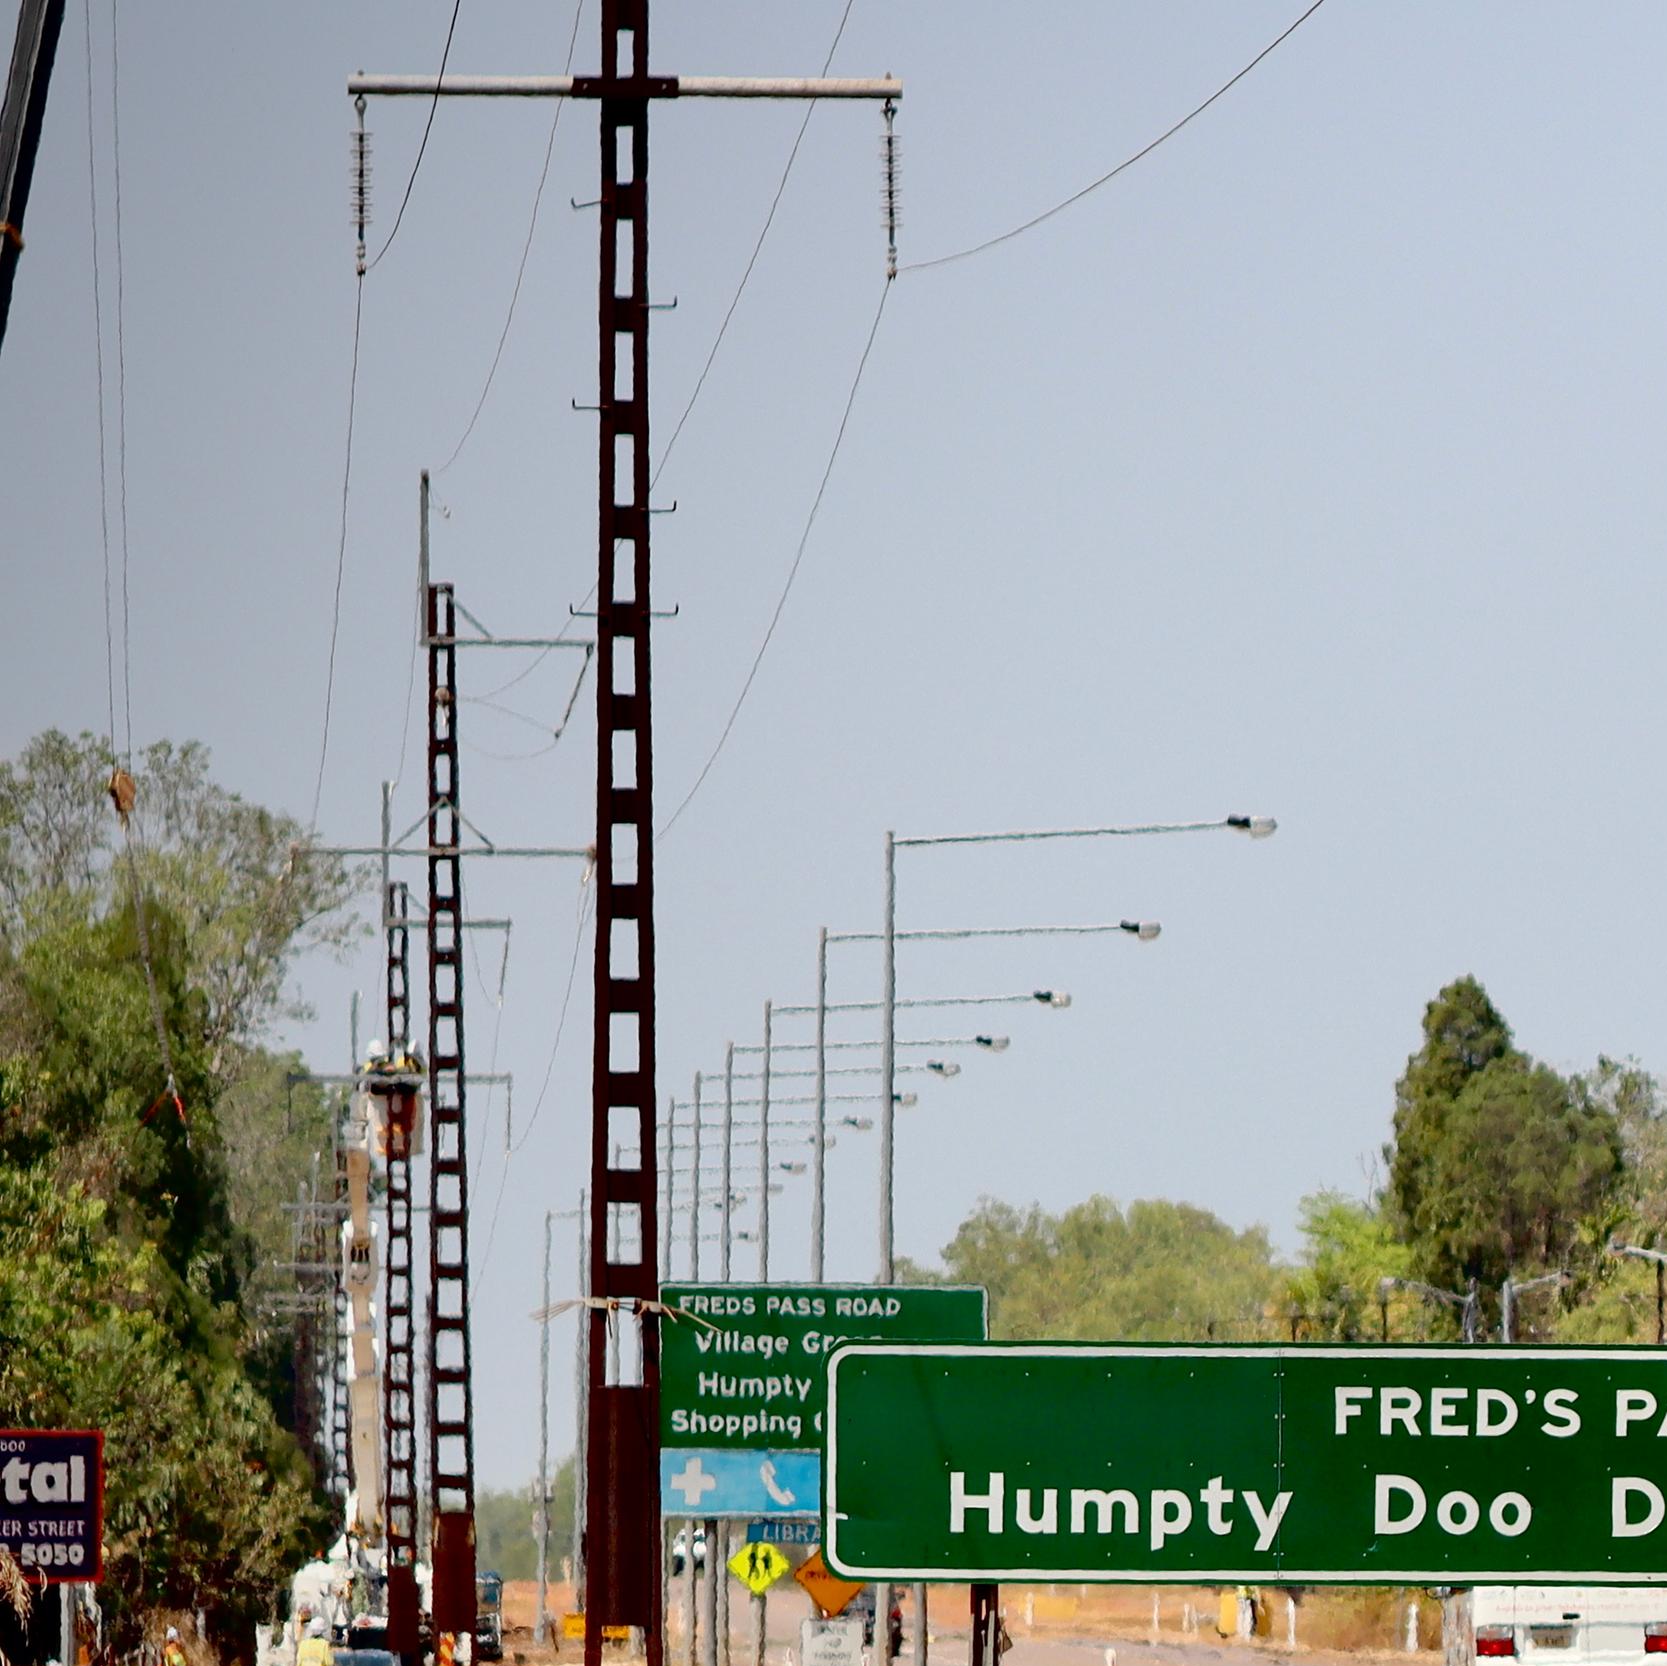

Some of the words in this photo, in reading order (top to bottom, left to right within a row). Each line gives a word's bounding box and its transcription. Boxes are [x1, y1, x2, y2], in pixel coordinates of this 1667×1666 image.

[679, 1296, 756, 1315] FREDS
[766, 1297, 826, 1316] PASS
[835, 1298, 901, 1316] ROAD
[695, 1331, 789, 1359] Village
[698, 1372, 812, 1401] Humpty
[671, 1409, 802, 1439] Shopping
[1335, 1386, 1581, 1438] FRED'S
[949, 1471, 1294, 1552] Humpty
[1374, 1475, 1532, 1537] Doo
[28, 1520, 85, 1536] STREET
